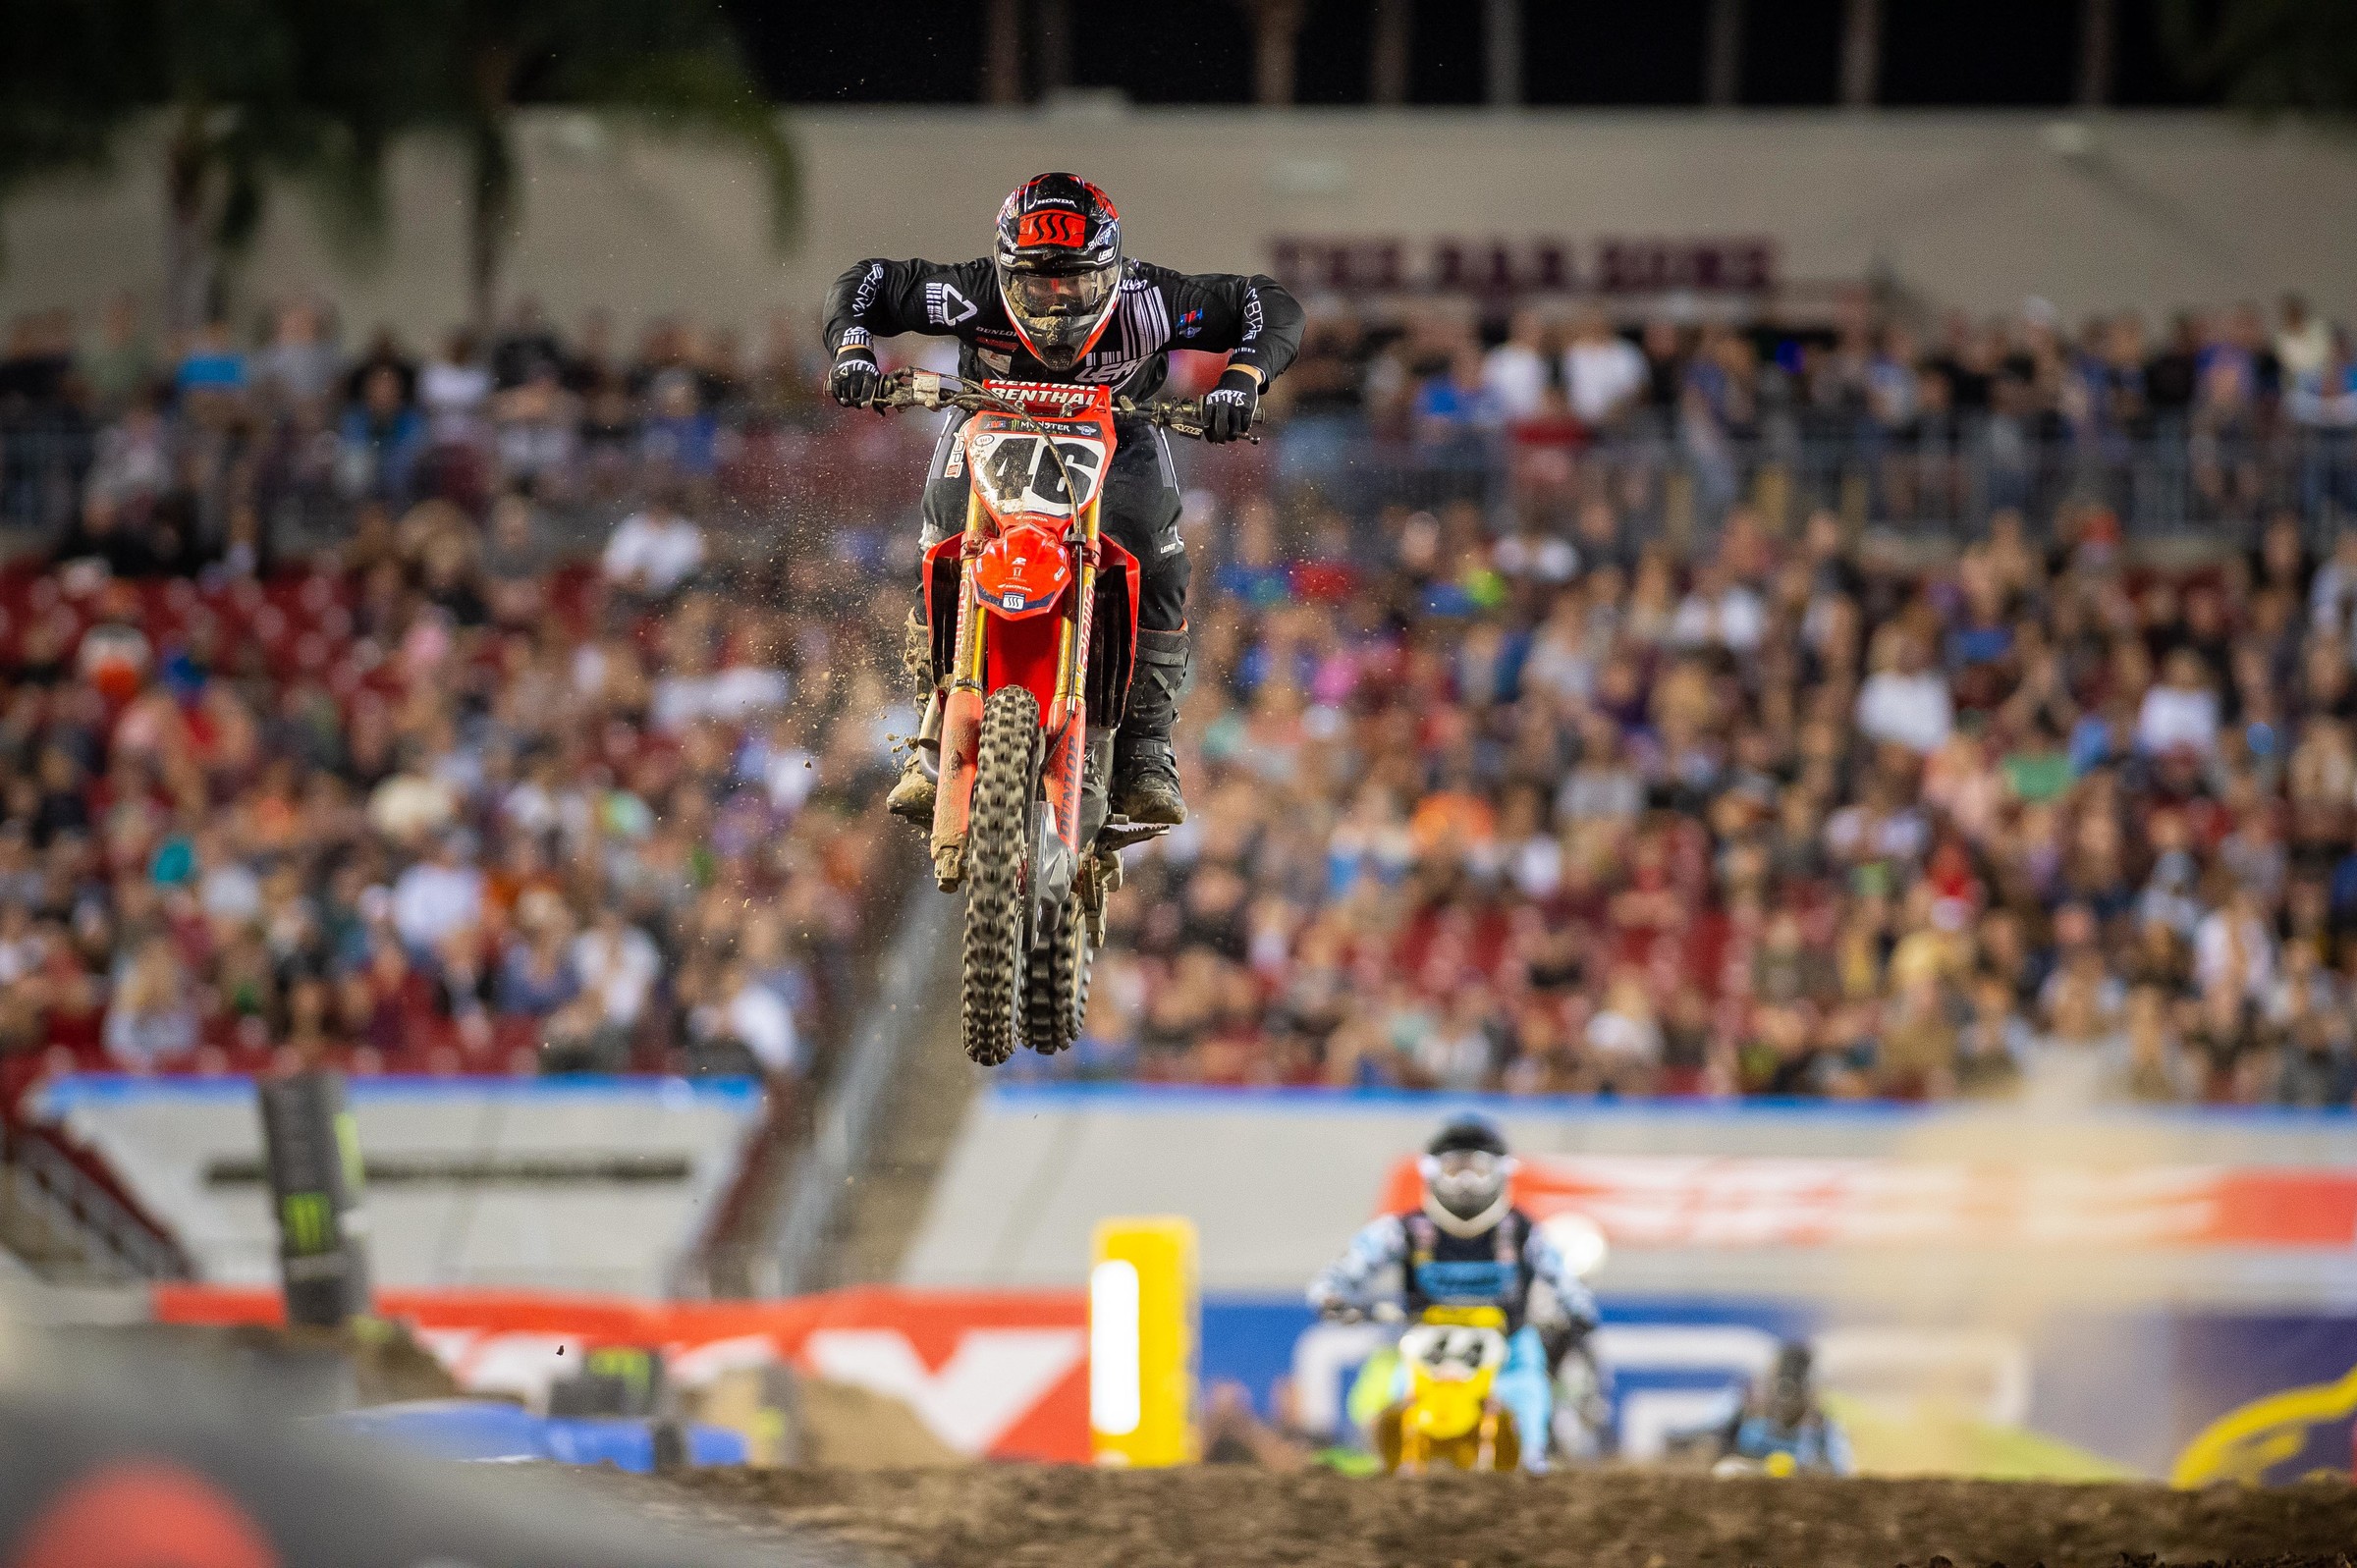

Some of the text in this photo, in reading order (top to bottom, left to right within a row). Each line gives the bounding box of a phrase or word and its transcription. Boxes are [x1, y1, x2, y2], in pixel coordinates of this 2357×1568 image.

[1036, 197, 1078, 209] HONDA
[991, 387, 1095, 406] RENTHAL
[982, 438, 1099, 505] 46
[1059, 734, 1079, 838] DUNLOP
